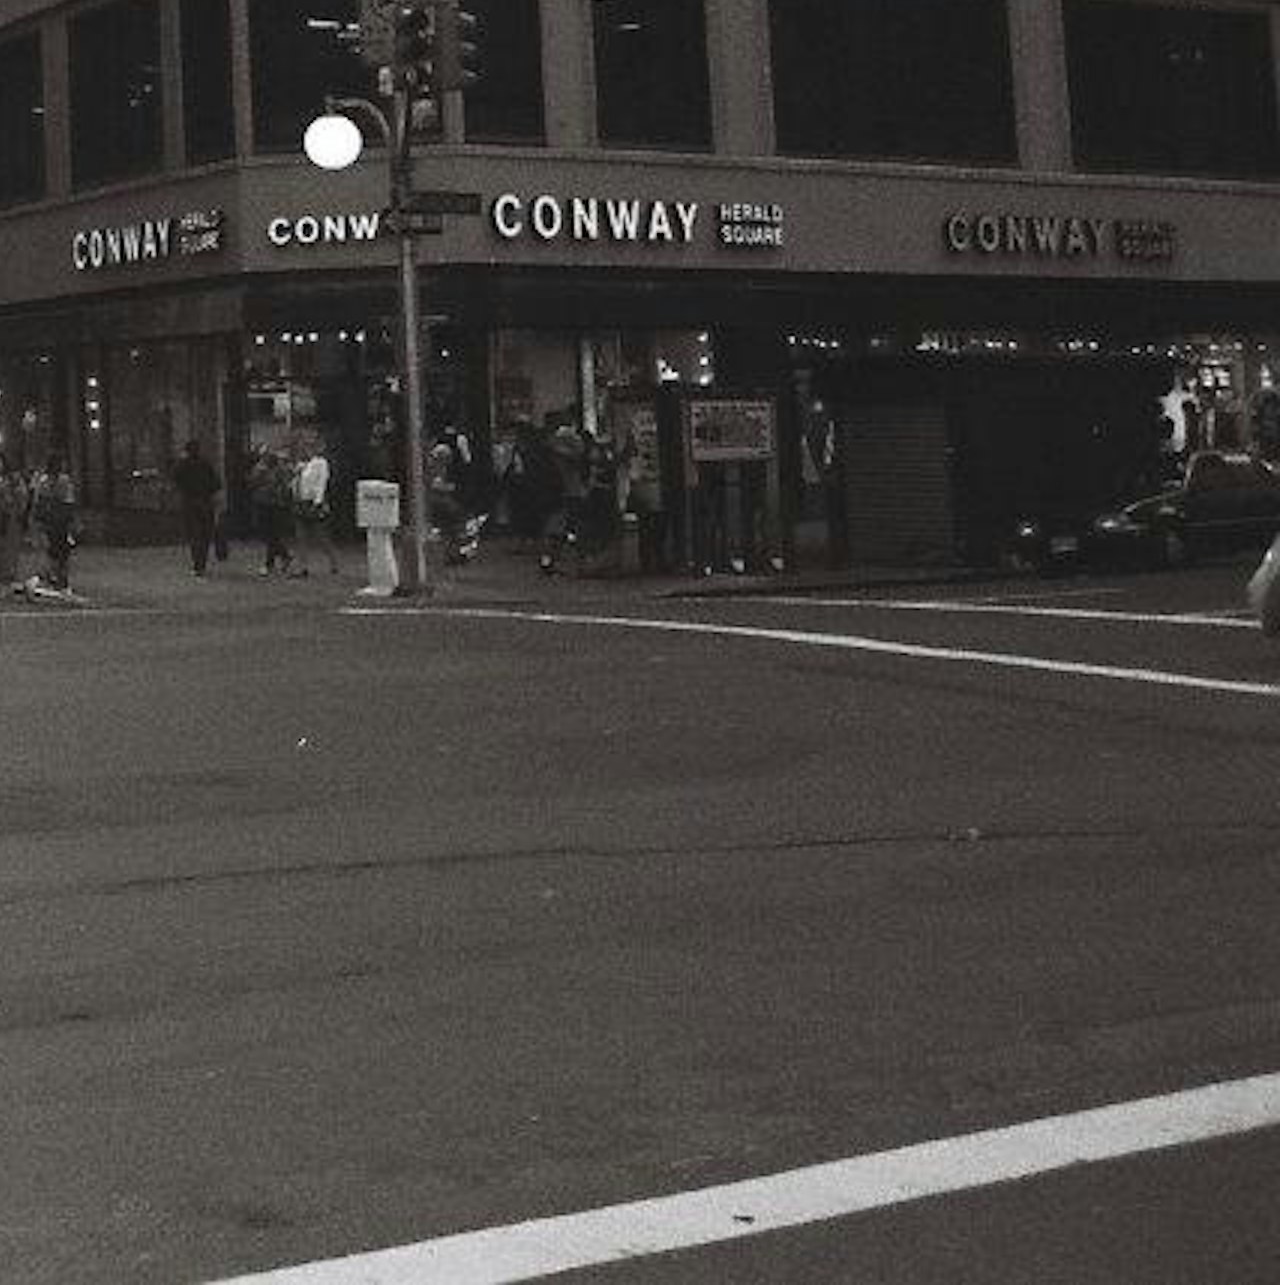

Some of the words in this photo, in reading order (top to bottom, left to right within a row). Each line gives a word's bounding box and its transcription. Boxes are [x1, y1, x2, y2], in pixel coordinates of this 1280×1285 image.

[267, 212, 380, 246] CONW
[494, 193, 698, 242] CONWAY
[720, 203, 784, 223] HERALD
[72, 217, 171, 270] CONWAY
[720, 224, 784, 246] SQUARE
[947, 213, 1113, 255] CONWAY
